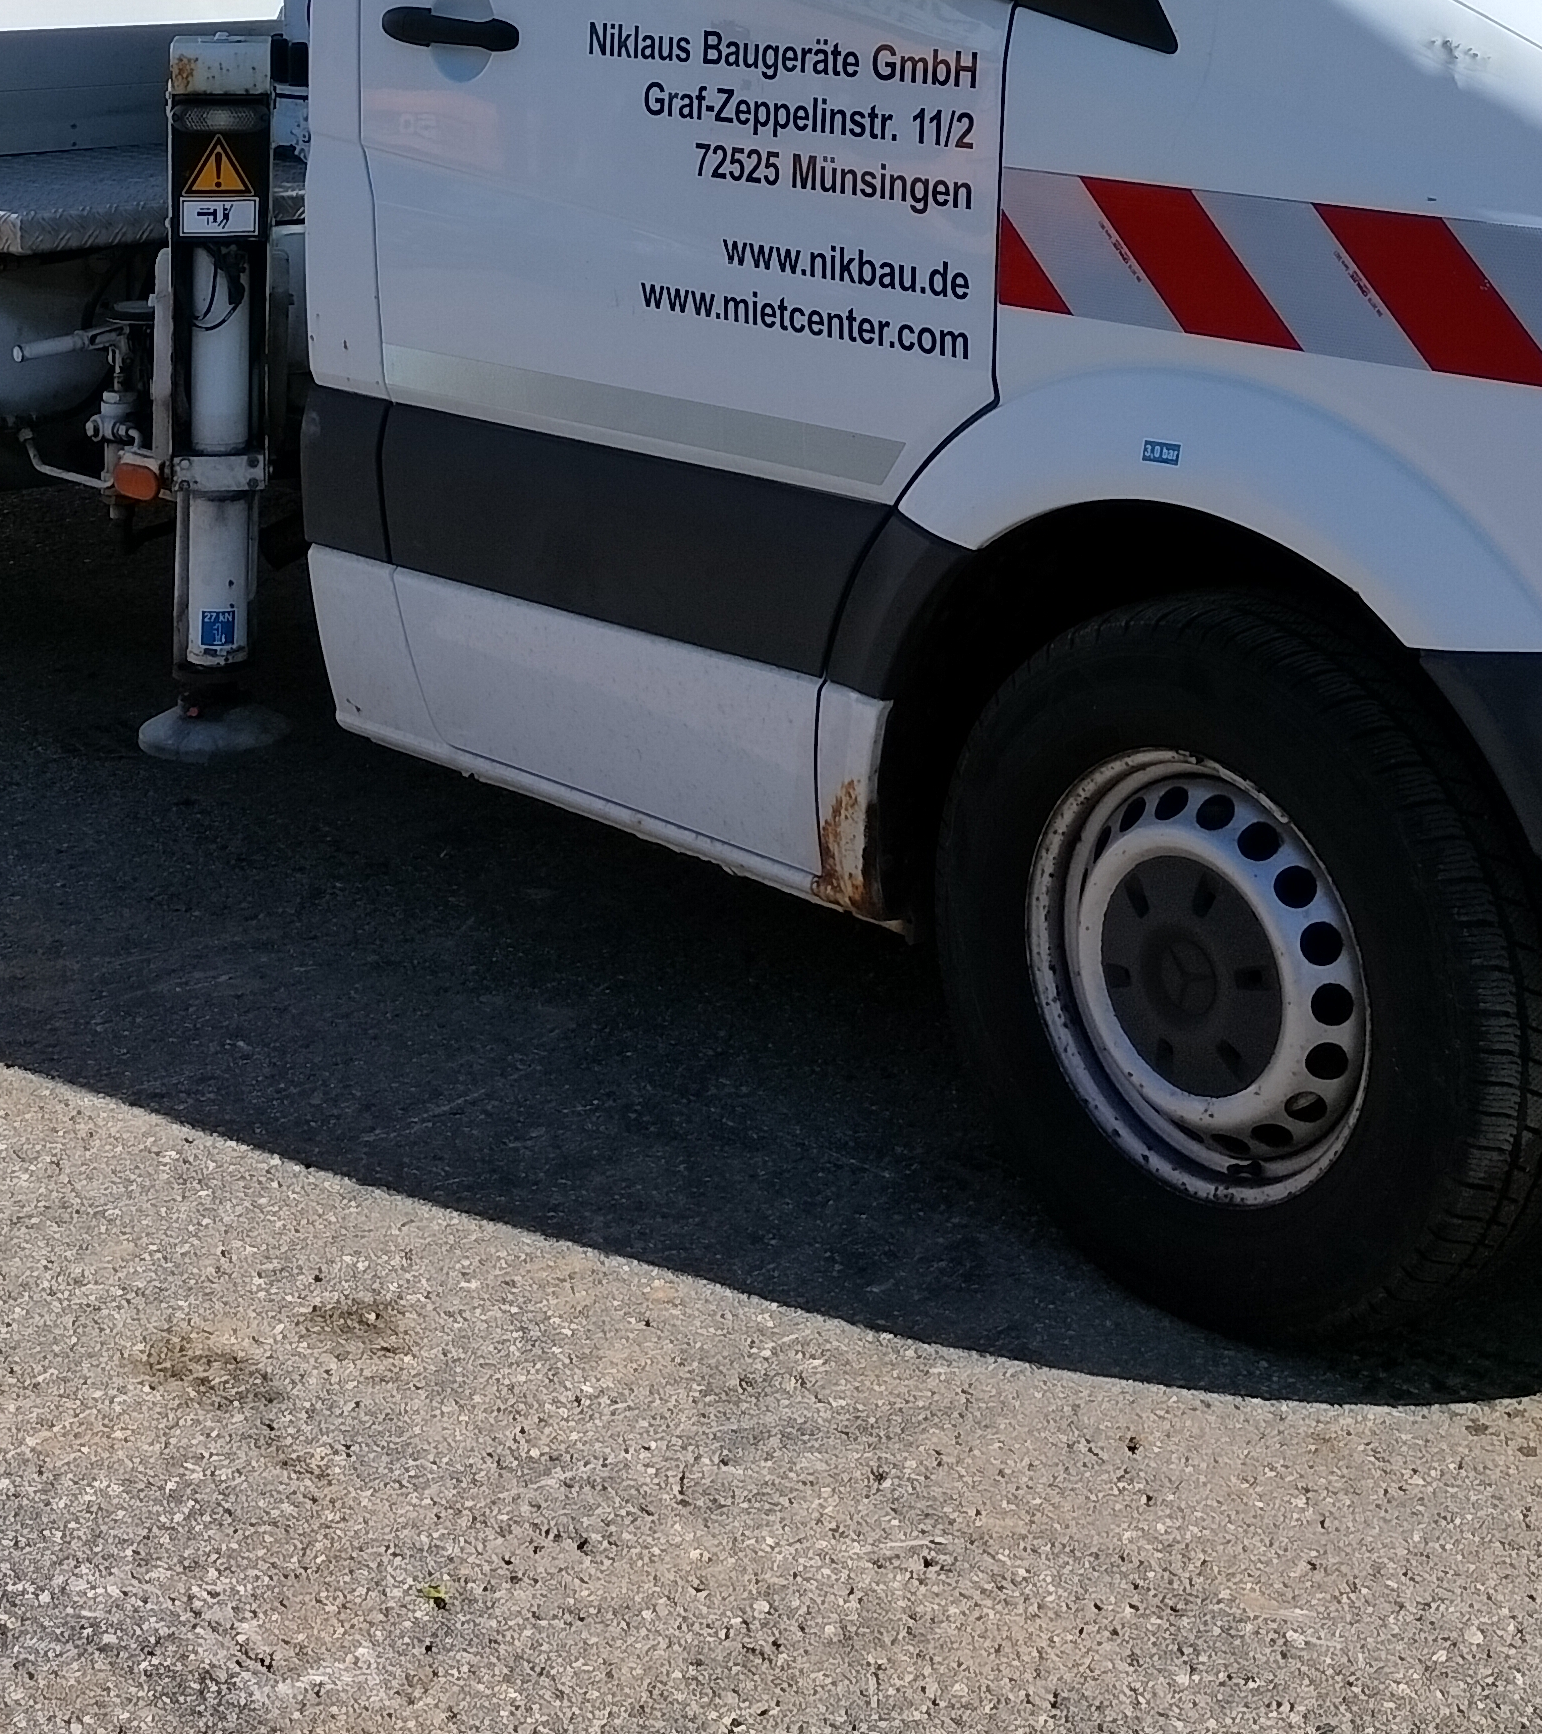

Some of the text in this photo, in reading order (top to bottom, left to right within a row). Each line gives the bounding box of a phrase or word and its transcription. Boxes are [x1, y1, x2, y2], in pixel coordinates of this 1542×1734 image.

[588, 21, 979, 89] Niklaus Baugeräte GmbH
[644, 82, 975, 149] Graf-Zeppelinstr. 11/2
[695, 142, 973, 214] 72525 Münsingen
[723, 239, 970, 300] www.nikbau.de
[641, 282, 969, 360] www.mietcenter.com
[1144, 444, 1178, 460] 3,0 bar
[204, 612, 233, 622] 27 kN
